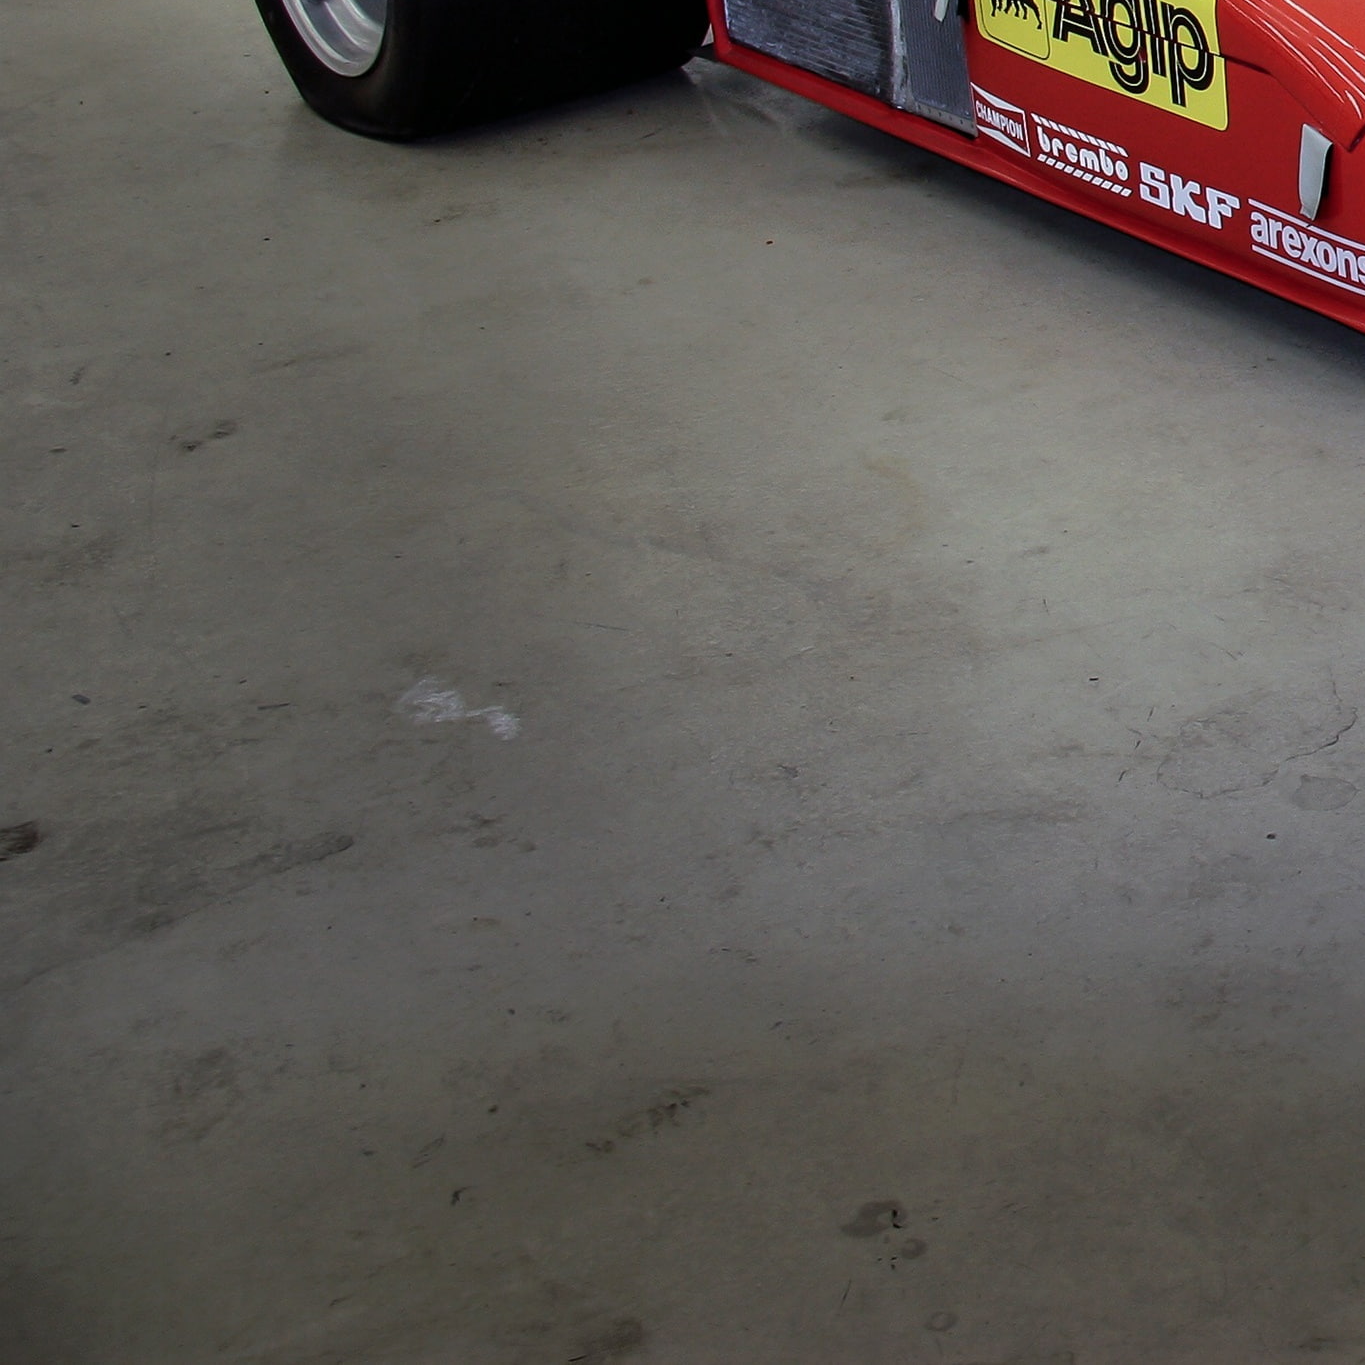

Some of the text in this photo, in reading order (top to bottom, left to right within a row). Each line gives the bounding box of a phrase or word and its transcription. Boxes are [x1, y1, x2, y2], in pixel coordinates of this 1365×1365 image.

[975, 99, 1024, 142] CHAMPION
[1036, 125, 1129, 182] brembo
[1138, 161, 1241, 230] SKF
